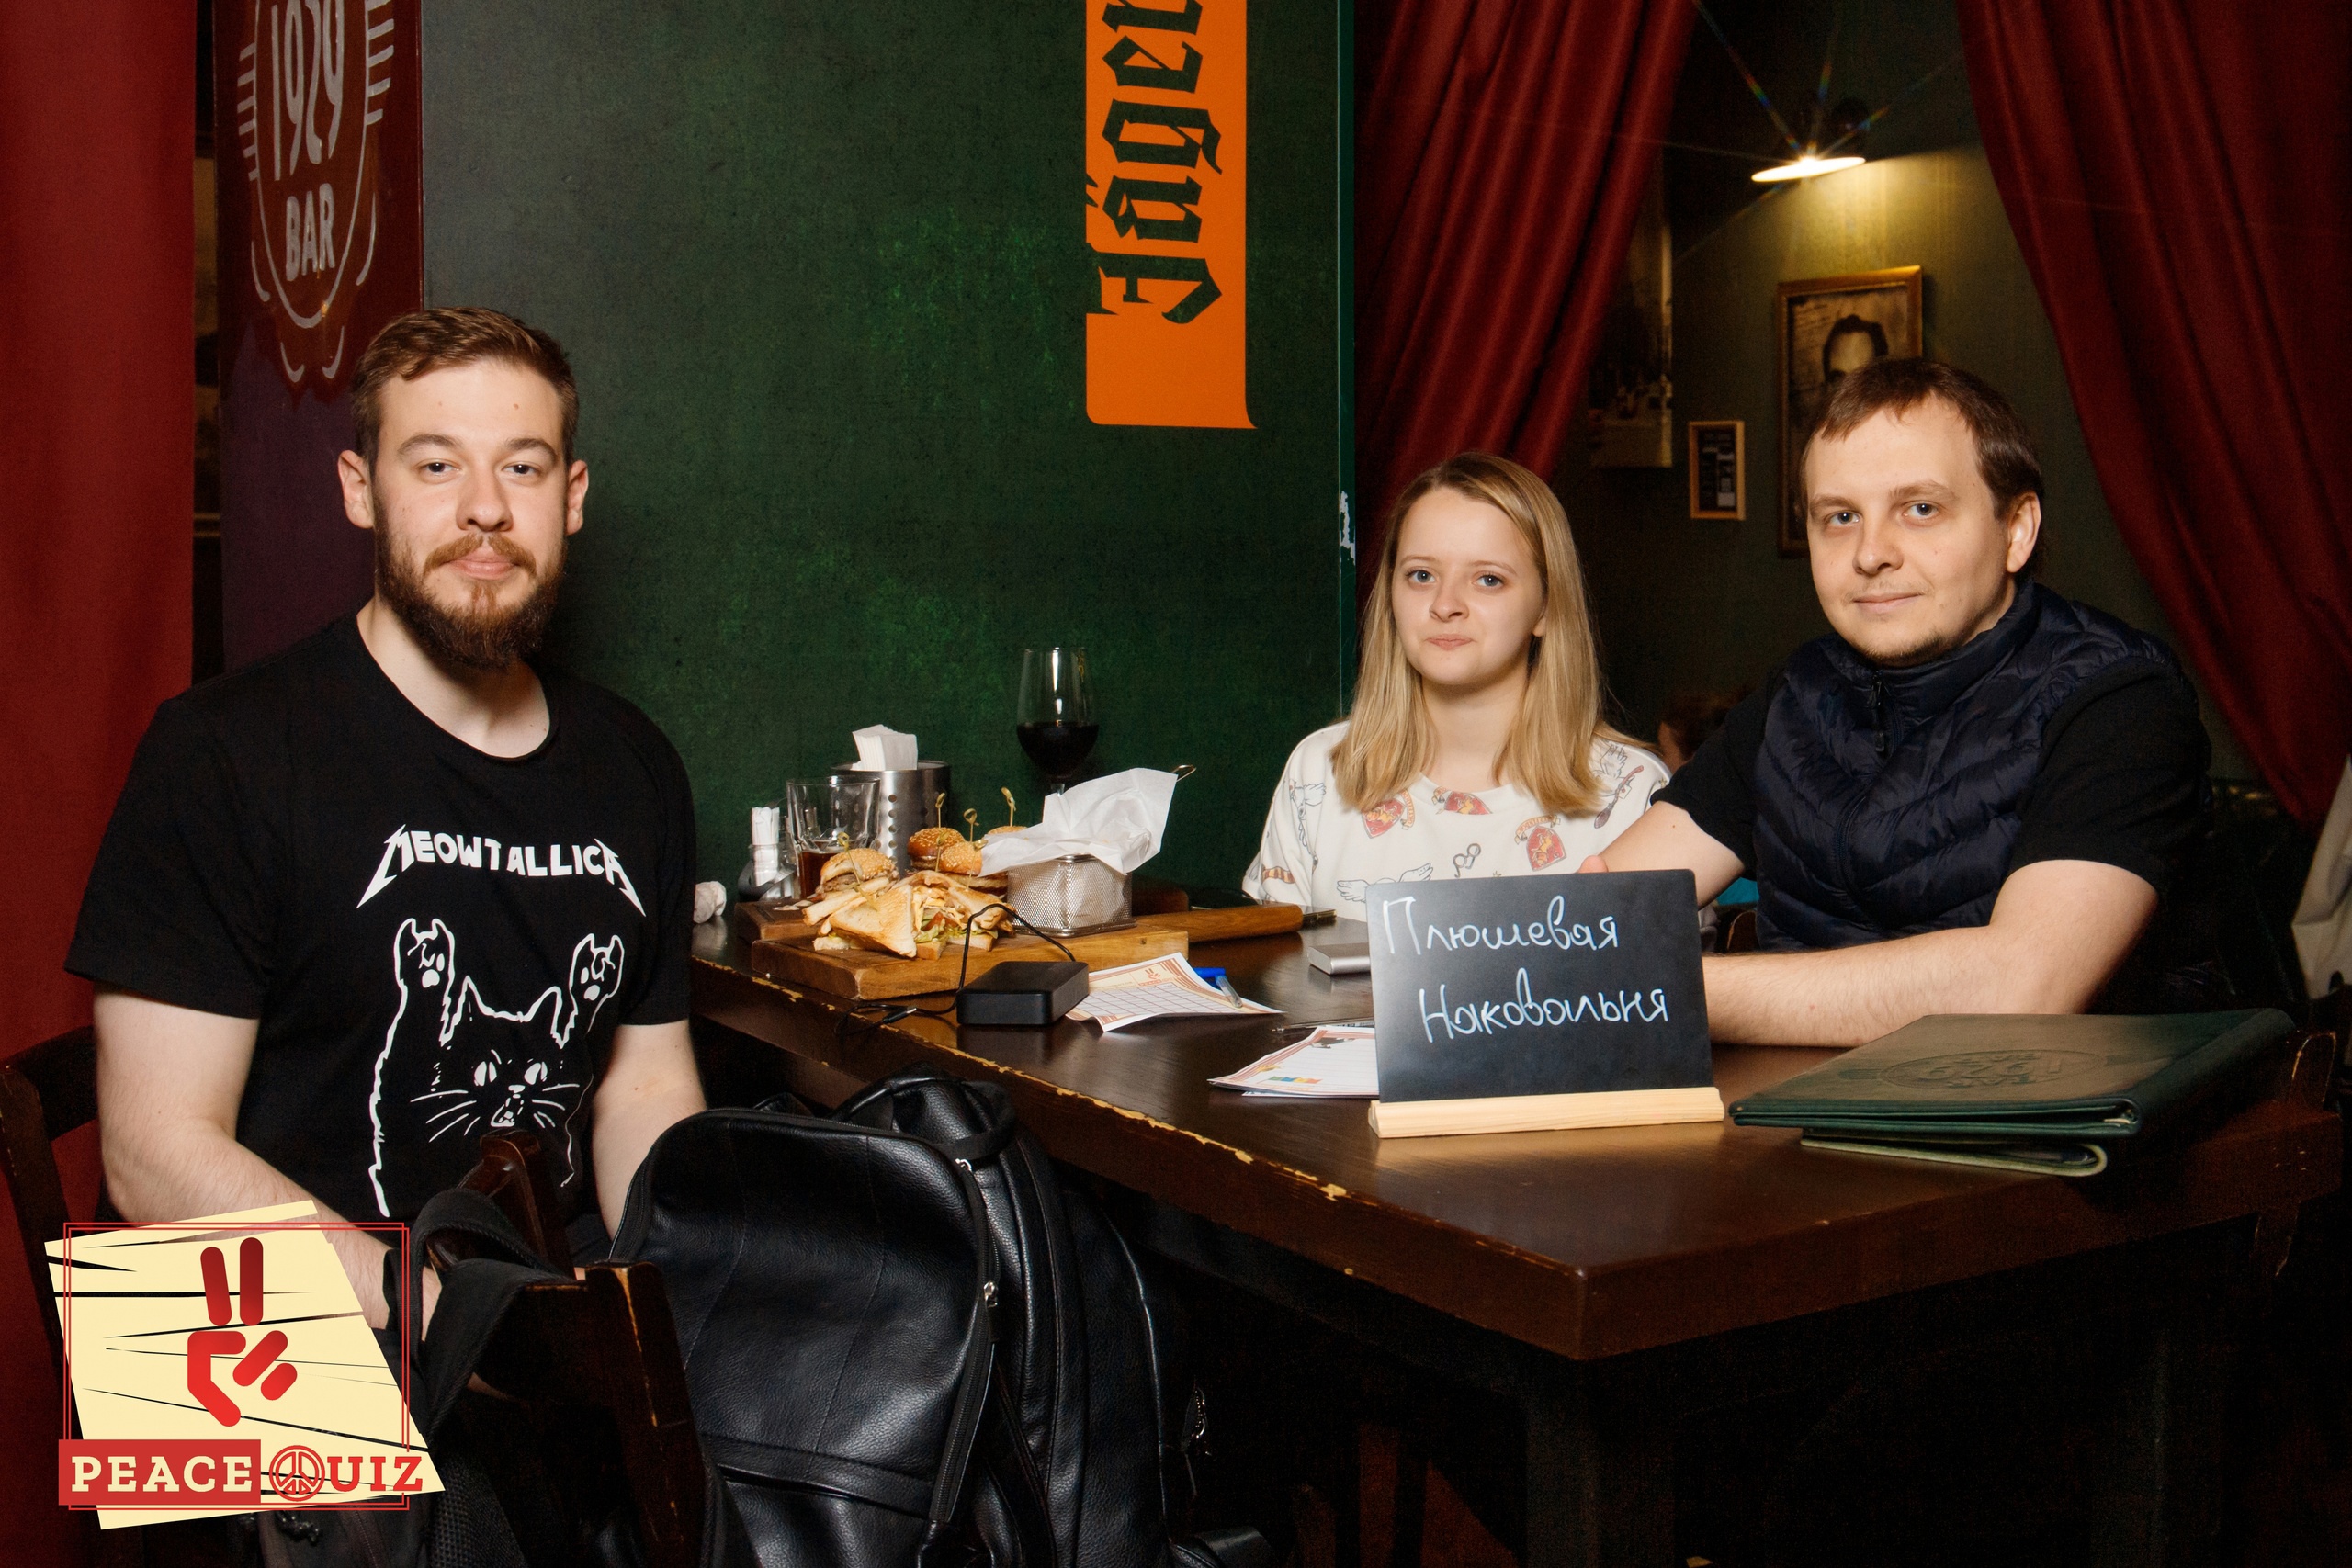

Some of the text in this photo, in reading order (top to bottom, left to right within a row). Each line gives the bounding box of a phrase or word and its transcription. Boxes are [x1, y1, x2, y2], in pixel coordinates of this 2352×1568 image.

[271, 0, 345, 181] 1929
[285, 183, 335, 282] BAR
[1383, 895, 1619, 955] Плюшевая
